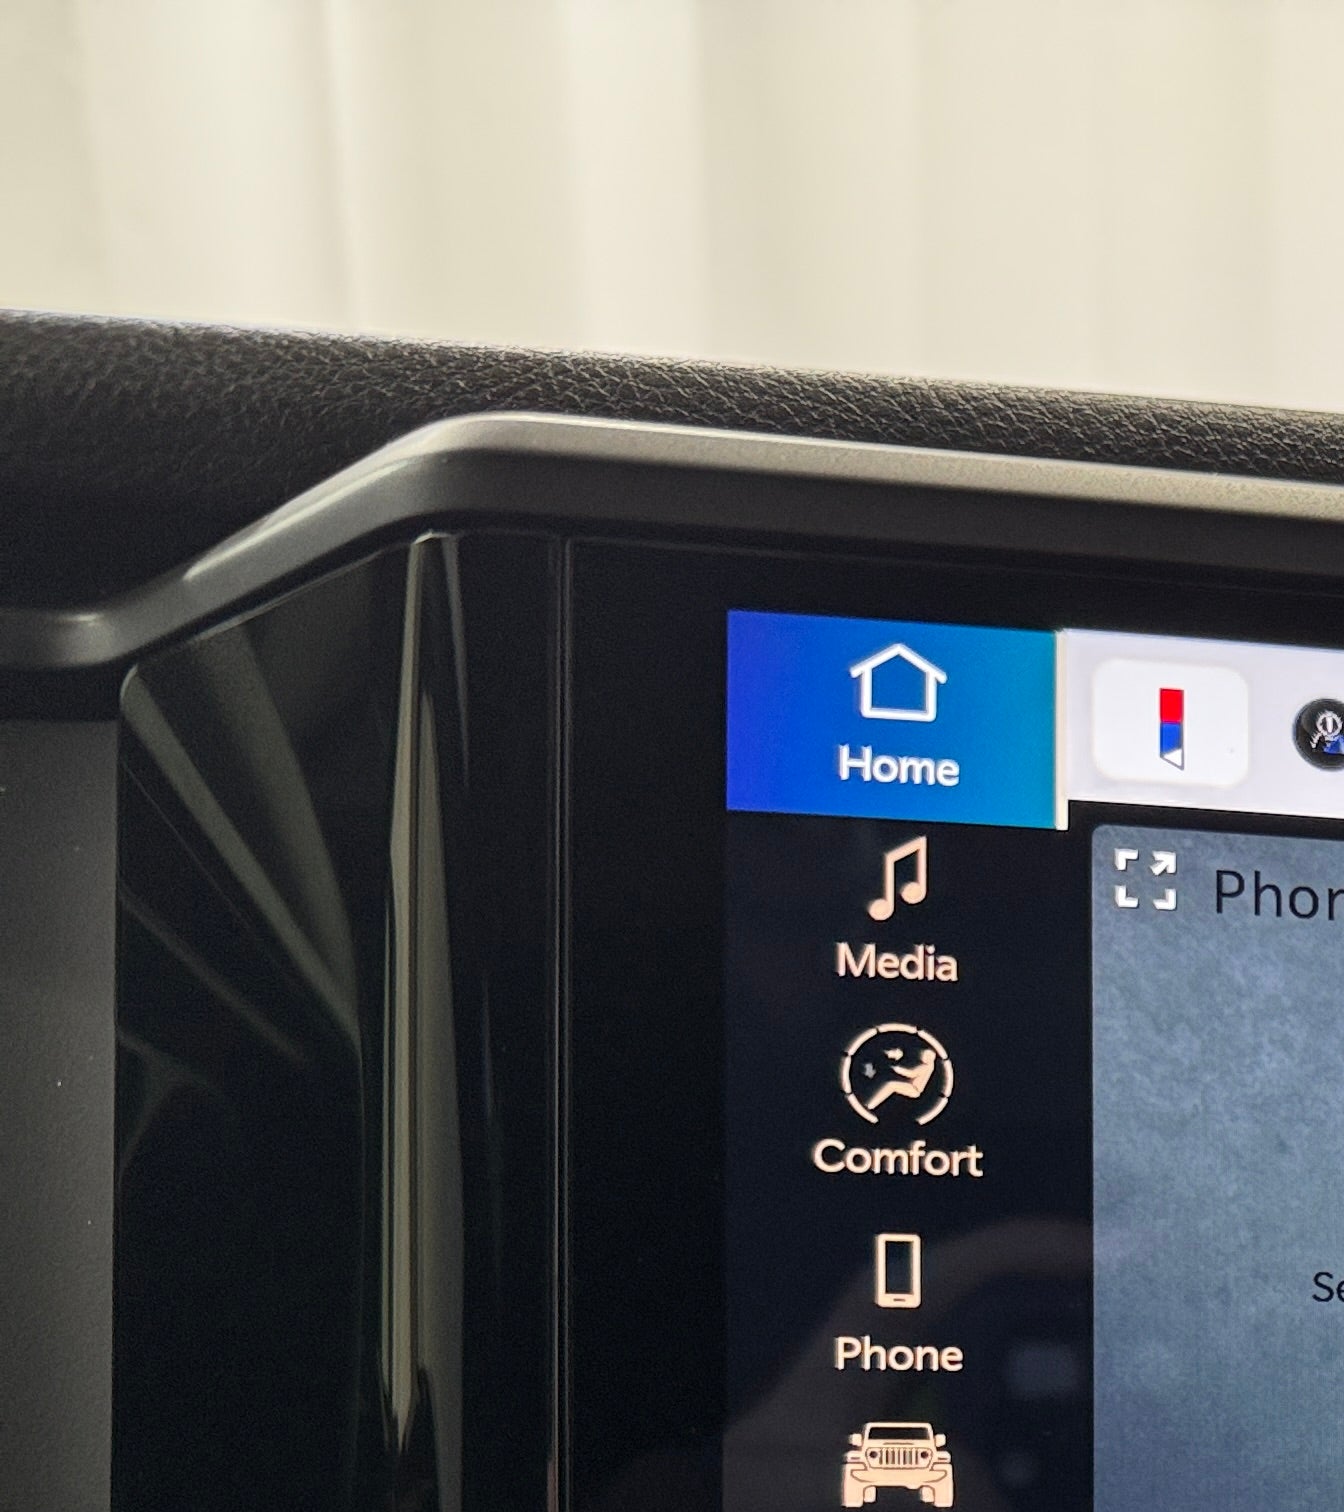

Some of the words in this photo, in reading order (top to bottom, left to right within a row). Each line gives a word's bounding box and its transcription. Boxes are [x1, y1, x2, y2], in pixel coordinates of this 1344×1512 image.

[838, 744, 960, 787] Home
[835, 941, 959, 983] Media
[811, 1138, 984, 1178] Comfort
[833, 1335, 965, 1373] Phone
